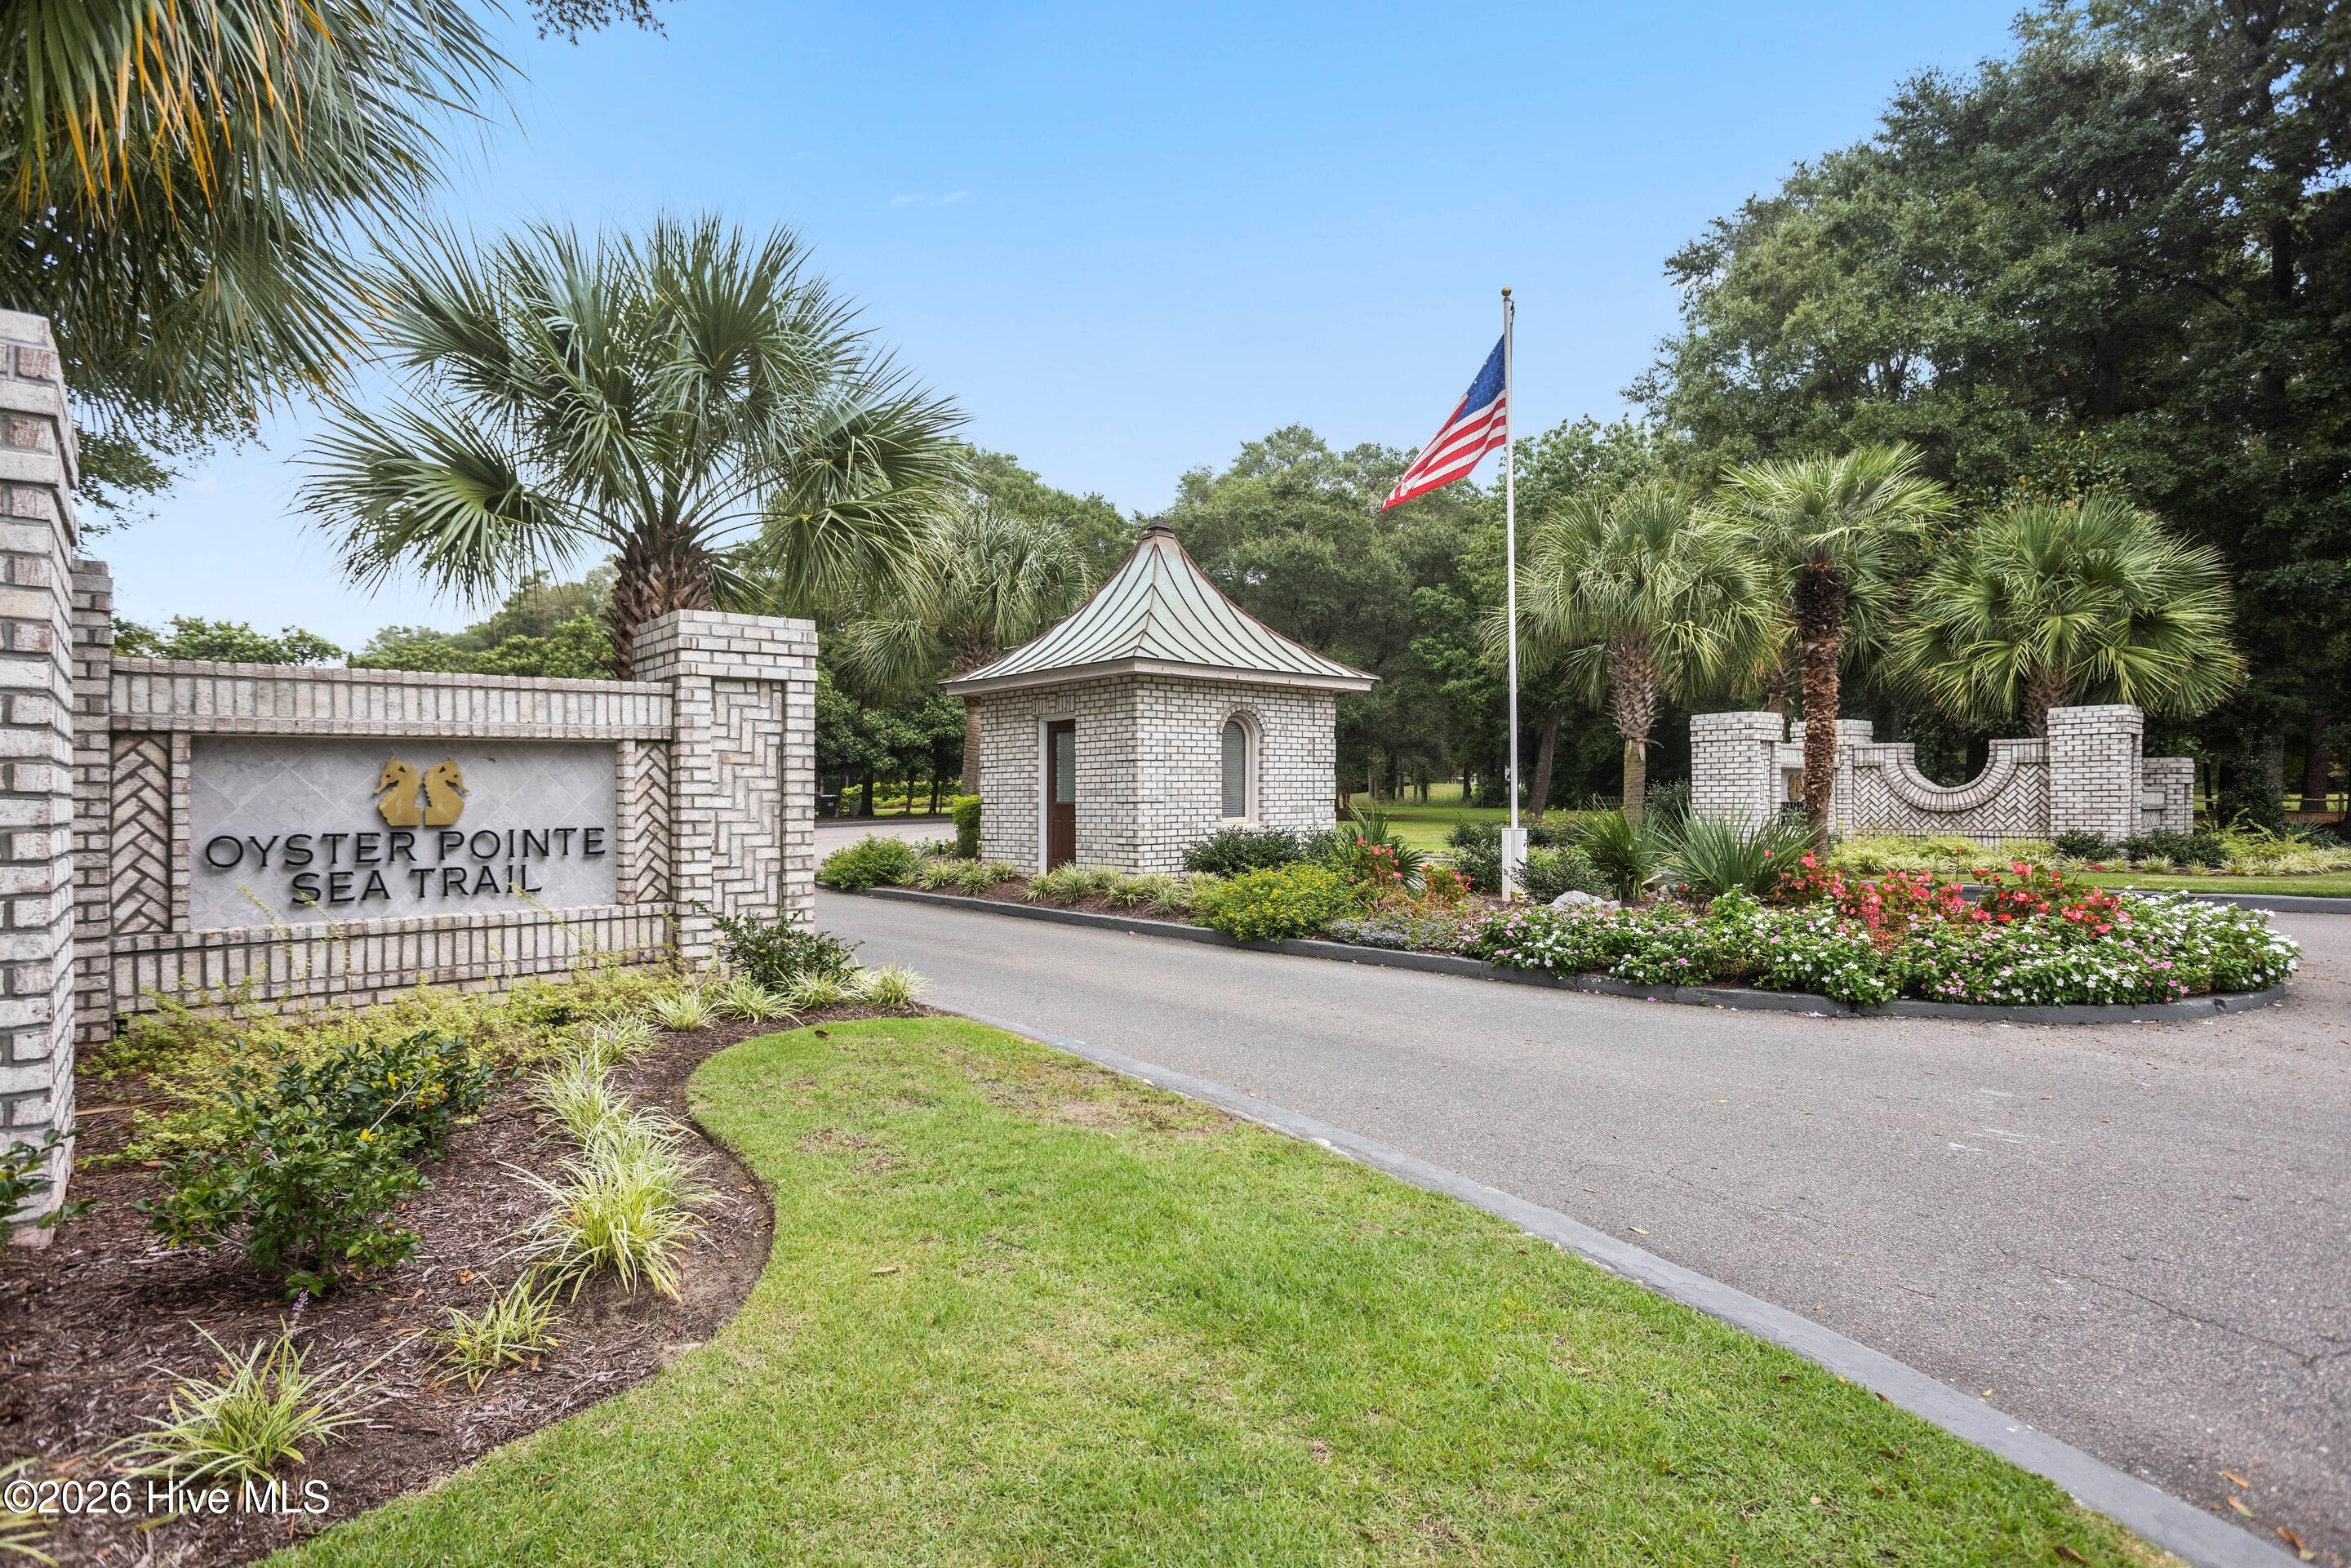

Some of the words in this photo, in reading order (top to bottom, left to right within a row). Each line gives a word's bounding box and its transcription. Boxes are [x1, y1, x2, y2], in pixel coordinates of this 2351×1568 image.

[206, 831, 416, 868] OYSTER
[439, 827, 607, 860] POINTE
[291, 869, 392, 904] SEA
[411, 864, 542, 898] TRAIL
